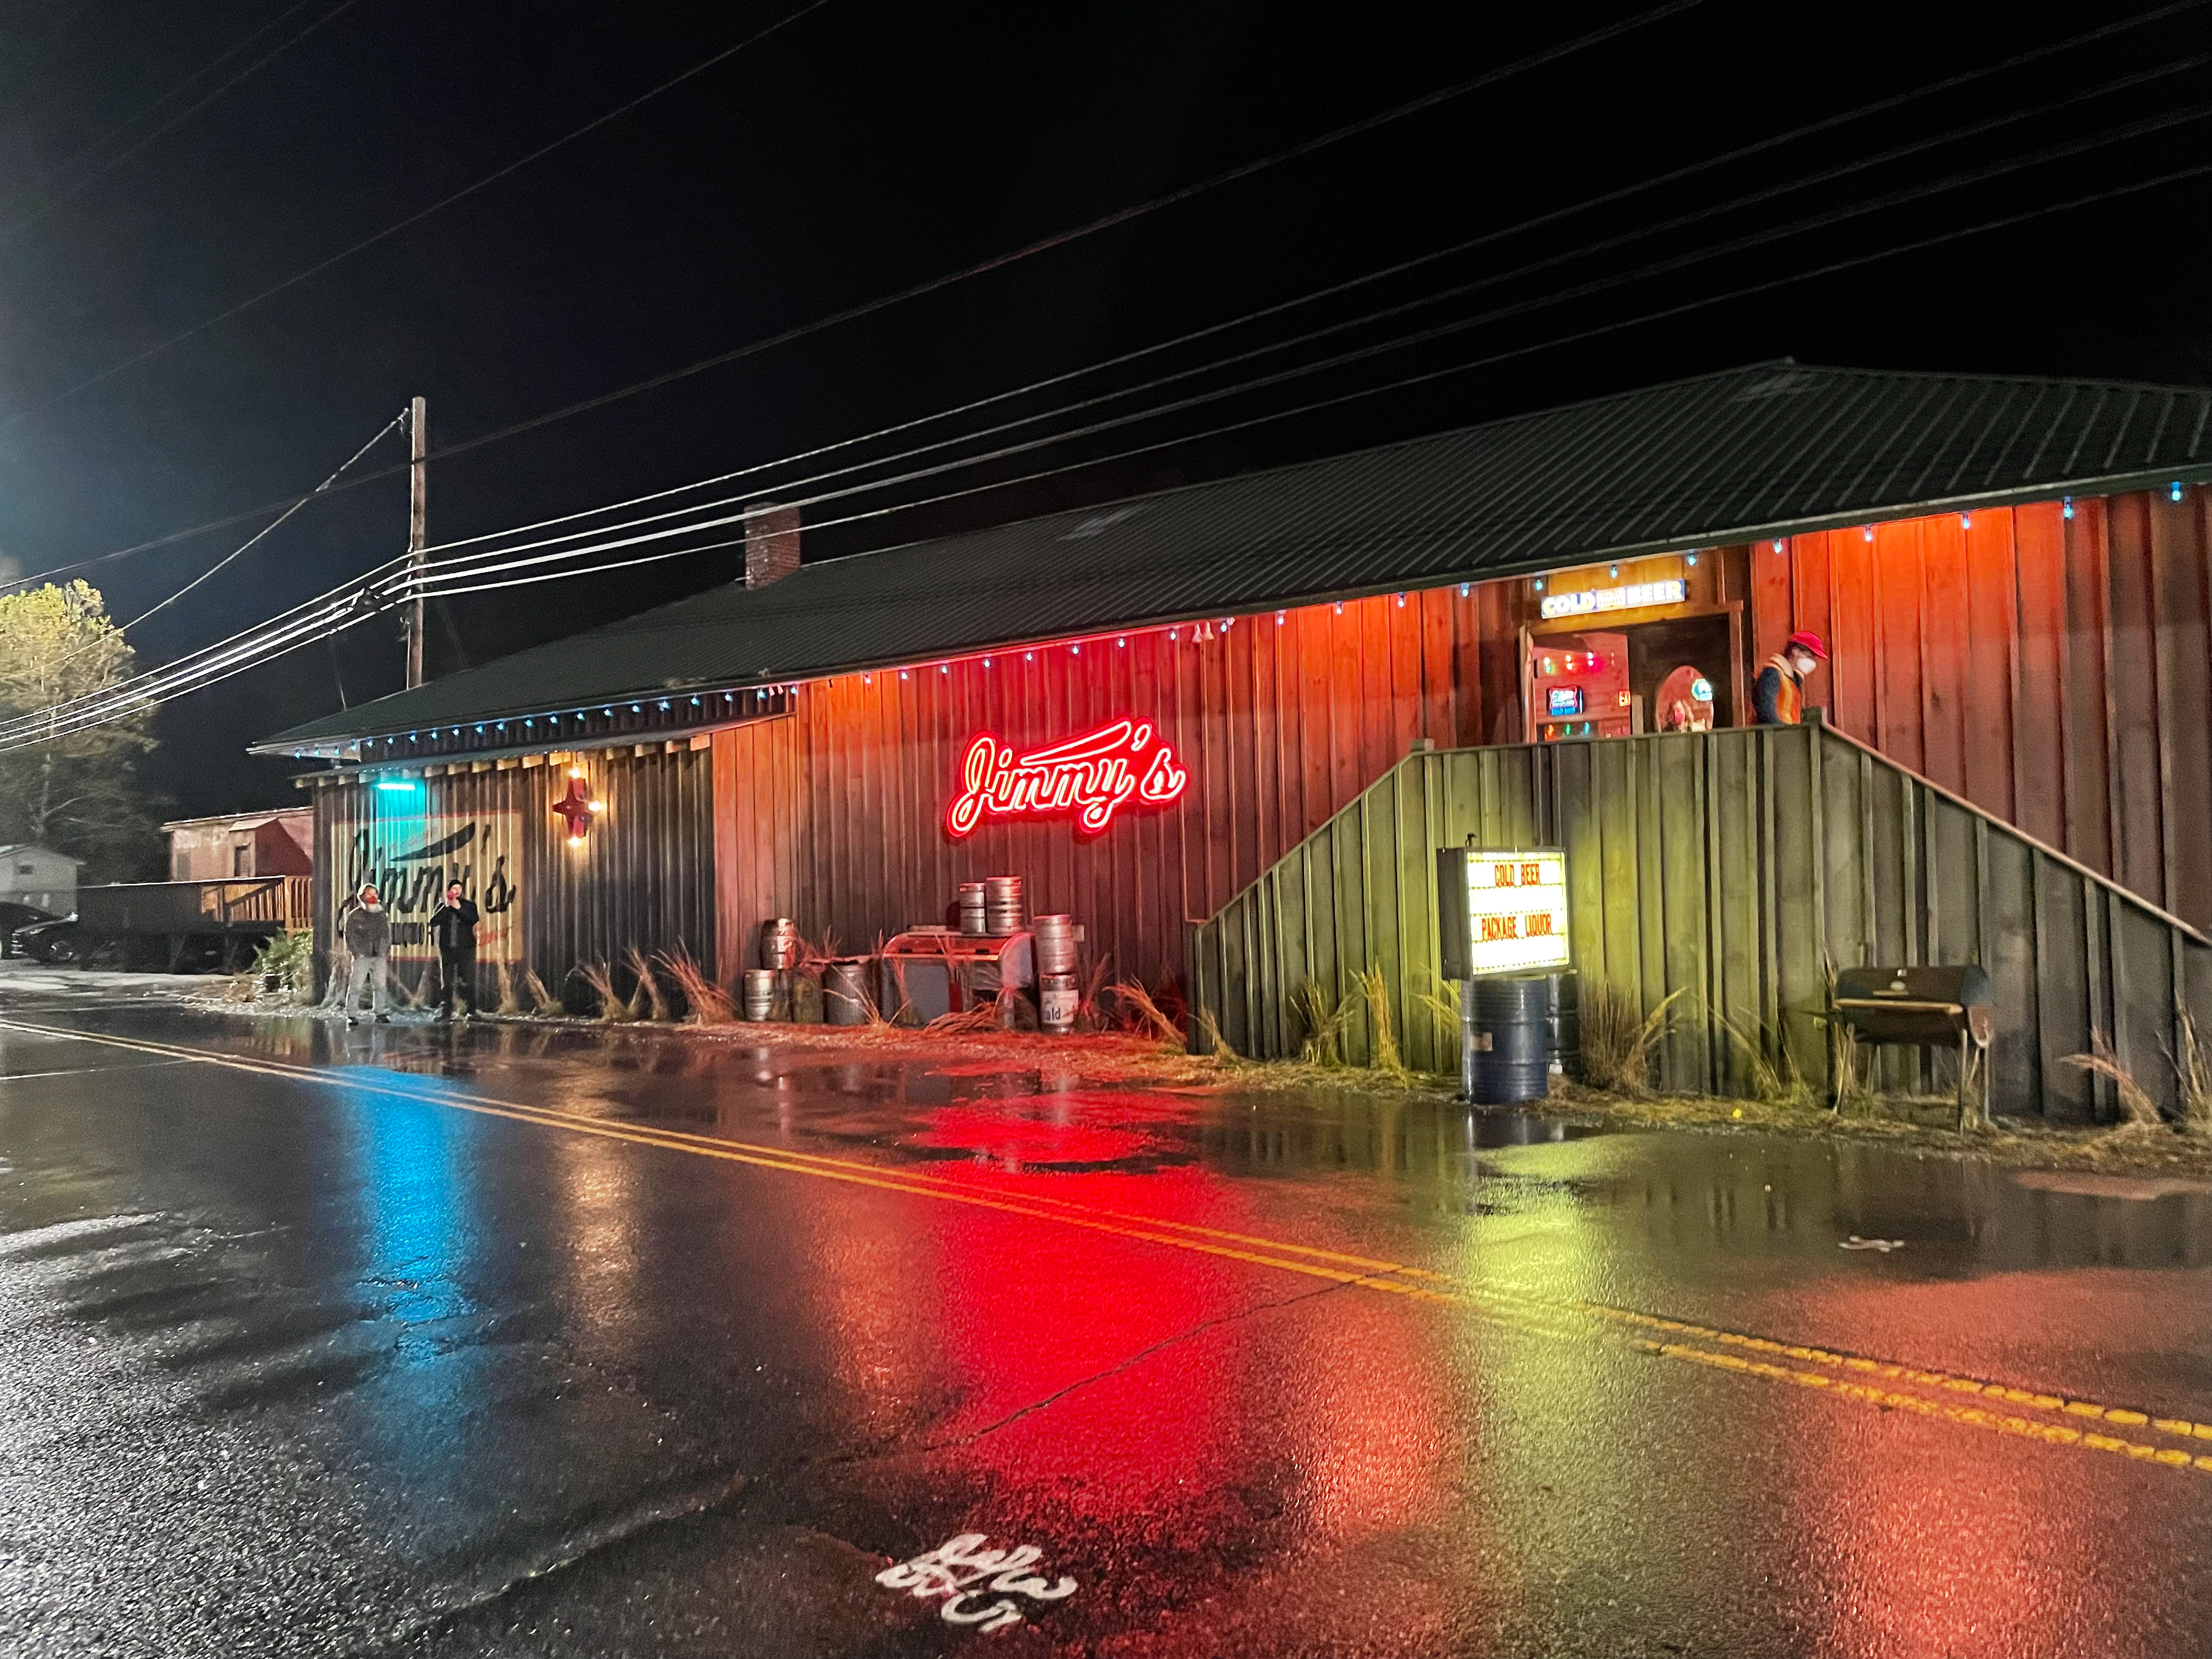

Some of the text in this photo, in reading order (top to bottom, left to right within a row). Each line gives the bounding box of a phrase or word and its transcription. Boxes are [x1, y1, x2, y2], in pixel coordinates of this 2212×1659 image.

[1543, 592, 1596, 616] COLD
[1626, 581, 1683, 605] BEER
[948, 718, 1188, 835] Jimmy's
[338, 822, 516, 938] Jimm's
[1494, 863, 1540, 887] COLD BEER
[1482, 914, 1552, 941] PACKAGE LIQUOR
